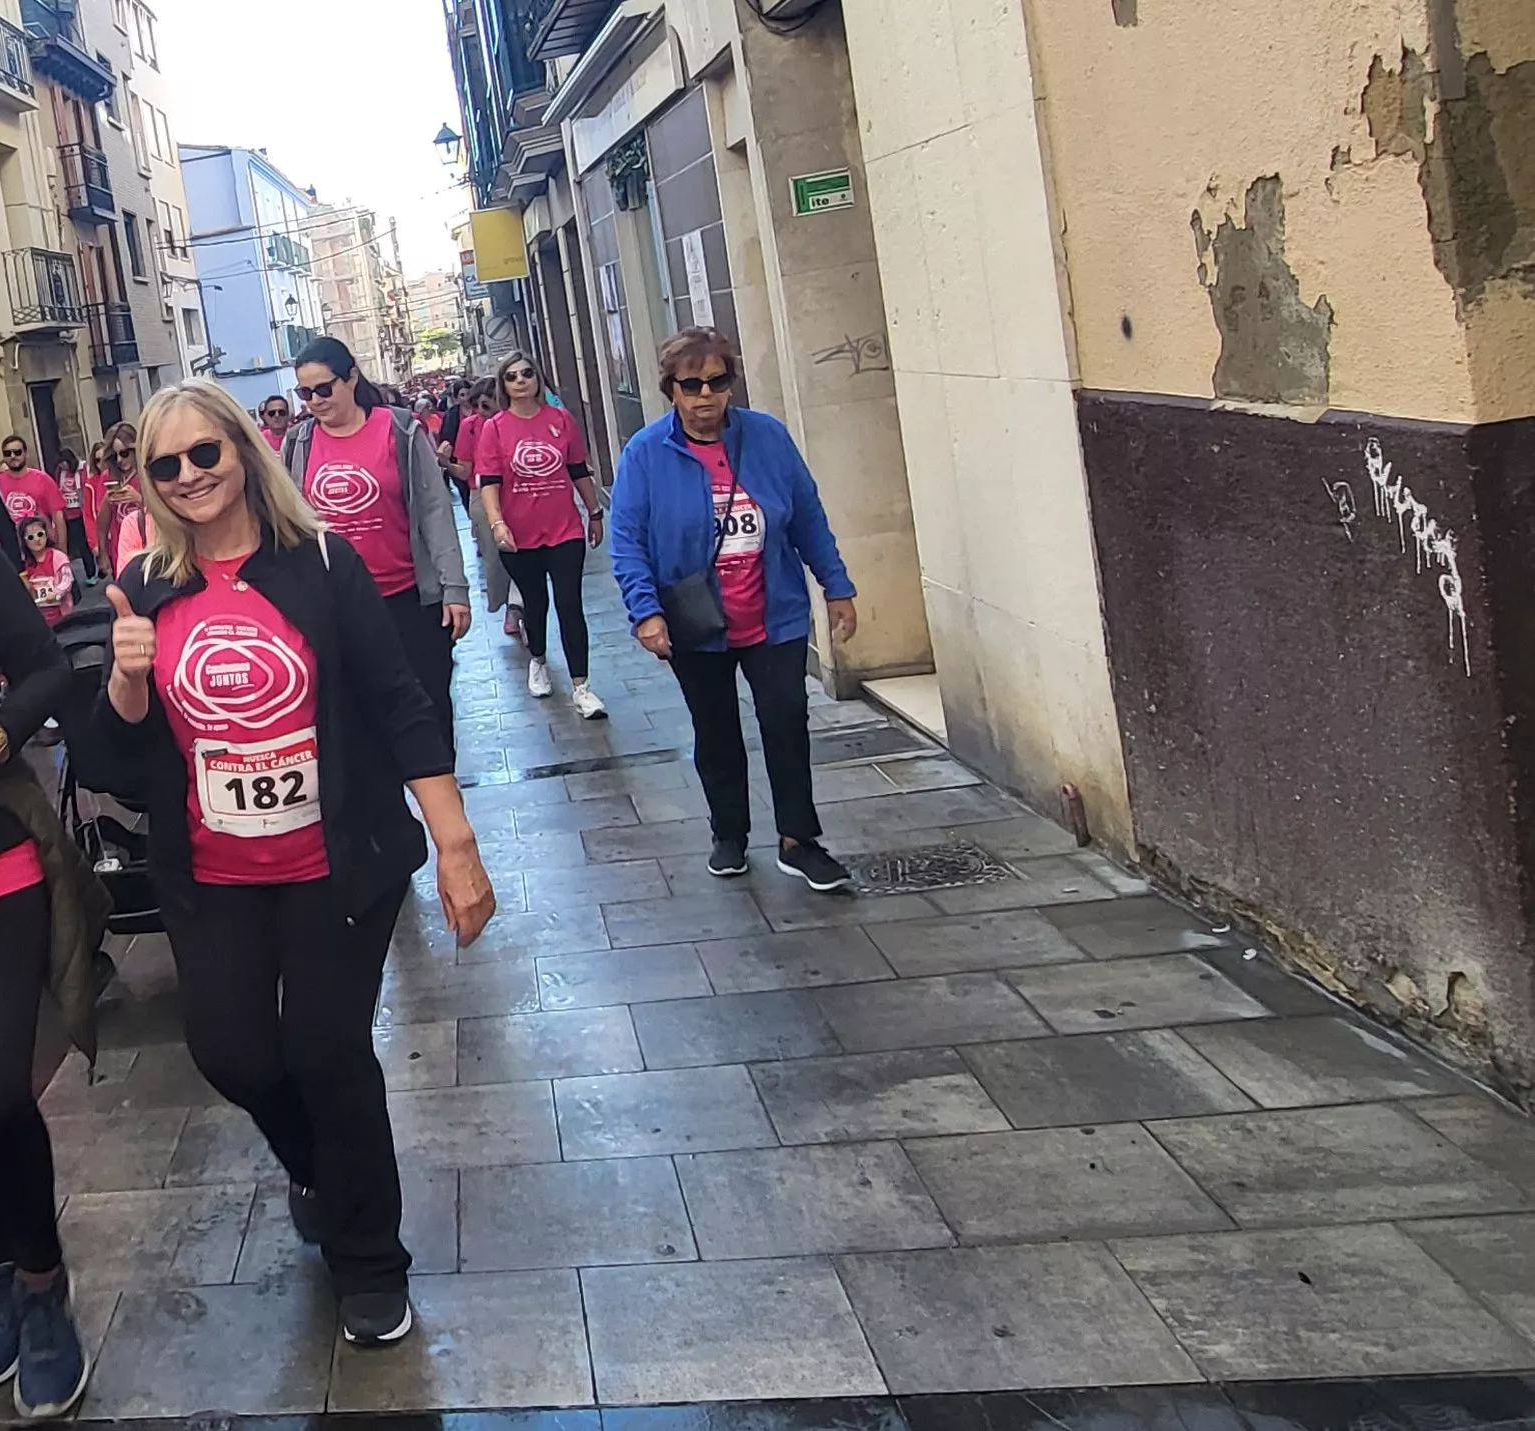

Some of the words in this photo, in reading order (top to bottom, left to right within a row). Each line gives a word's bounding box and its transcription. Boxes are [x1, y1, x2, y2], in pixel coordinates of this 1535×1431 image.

[209, 672, 249, 688] JUNTOS
[210, 760, 254, 772] CONTRA
[256, 762, 270, 771] EL
[270, 750, 314, 768] CÁNCER
[243, 752, 277, 763] HUESCA
[225, 770, 307, 810] 182
